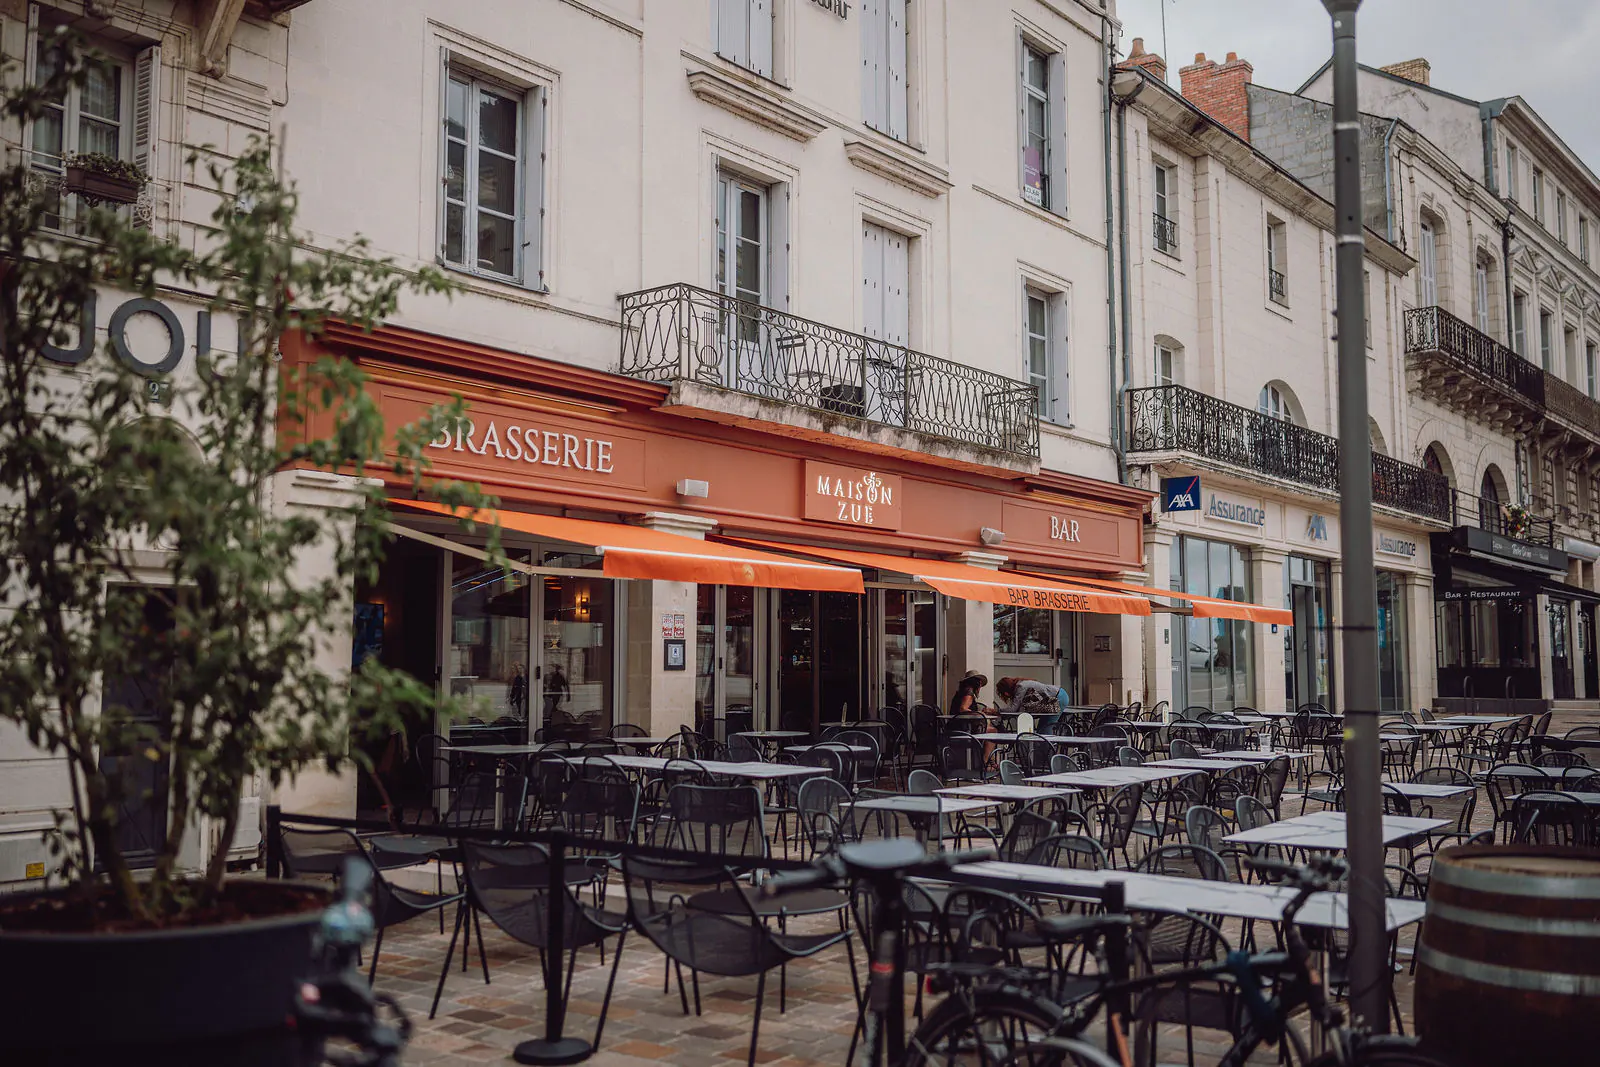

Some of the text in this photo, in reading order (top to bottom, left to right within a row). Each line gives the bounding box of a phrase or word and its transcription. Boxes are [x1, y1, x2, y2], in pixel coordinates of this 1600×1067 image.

[429, 412, 614, 474] BRASSERIE
[817, 473, 893, 505] MAISON
[1168, 493, 1195, 508] AXA
[1209, 493, 1266, 527] Assurance
[1050, 515, 1081, 543] BAR
[1008, 587, 1091, 611] BAR BRASSERIE
